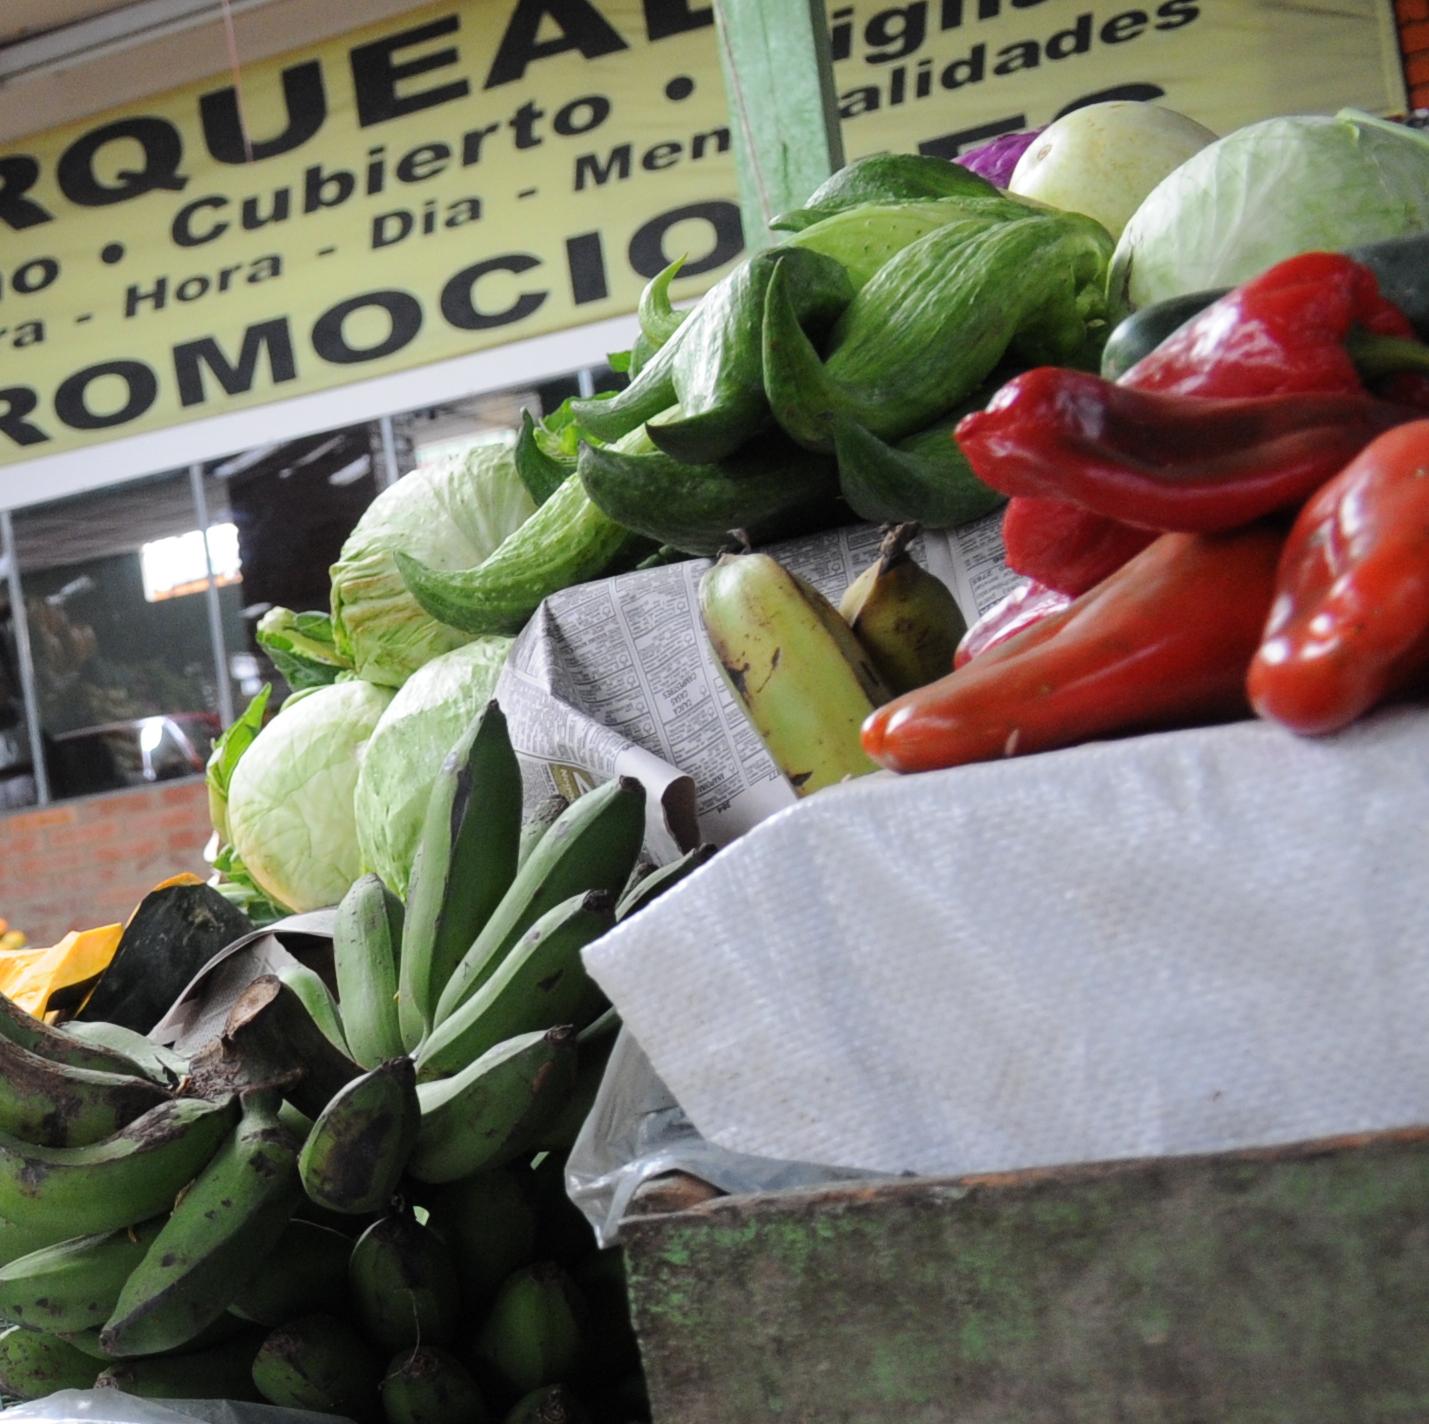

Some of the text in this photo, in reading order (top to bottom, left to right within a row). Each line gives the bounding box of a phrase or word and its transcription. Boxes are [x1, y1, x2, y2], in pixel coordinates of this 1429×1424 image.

[170, 95, 612, 248] Cubierto
[124, 253, 282, 319] Hora
[370, 195, 483, 251] Dia
